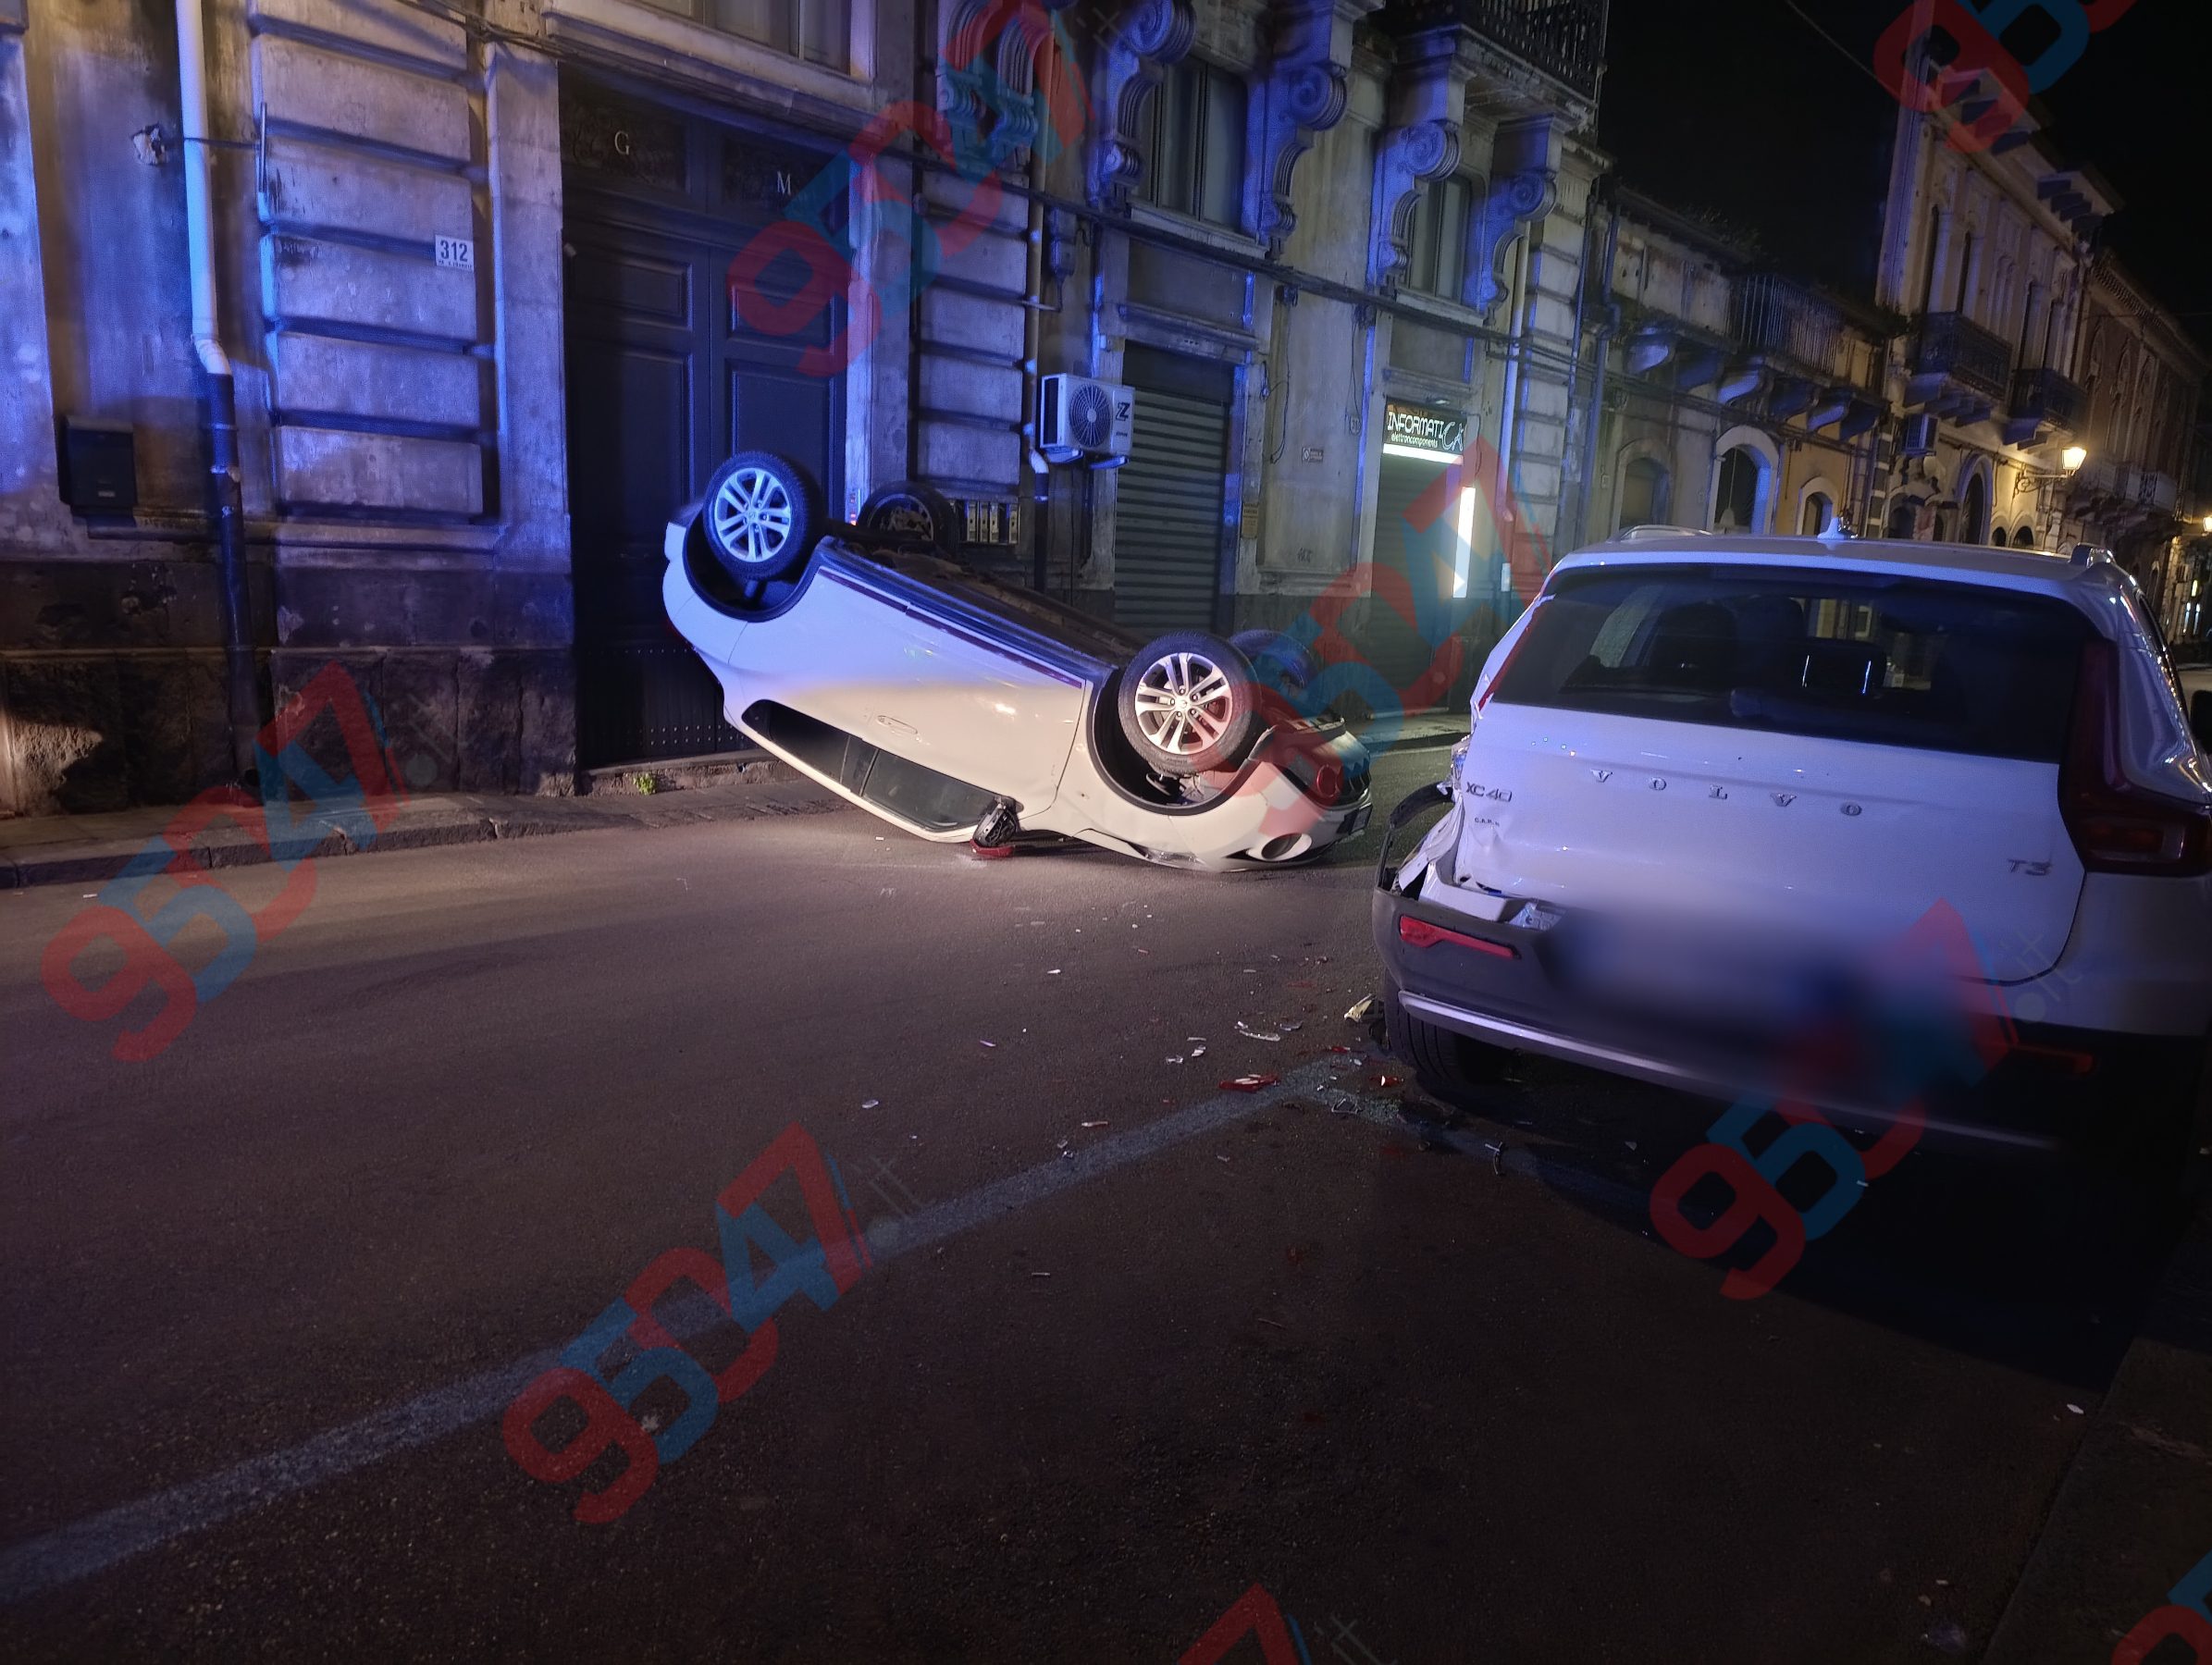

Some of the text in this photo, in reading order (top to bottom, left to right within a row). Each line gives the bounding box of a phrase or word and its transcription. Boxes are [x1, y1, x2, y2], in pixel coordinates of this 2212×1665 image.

[614, 130, 630, 155] G
[776, 170, 792, 196] M
[439, 240, 468, 263] 312
[1466, 782, 1513, 802] XC40
[1590, 769, 1862, 817] VOLVO
